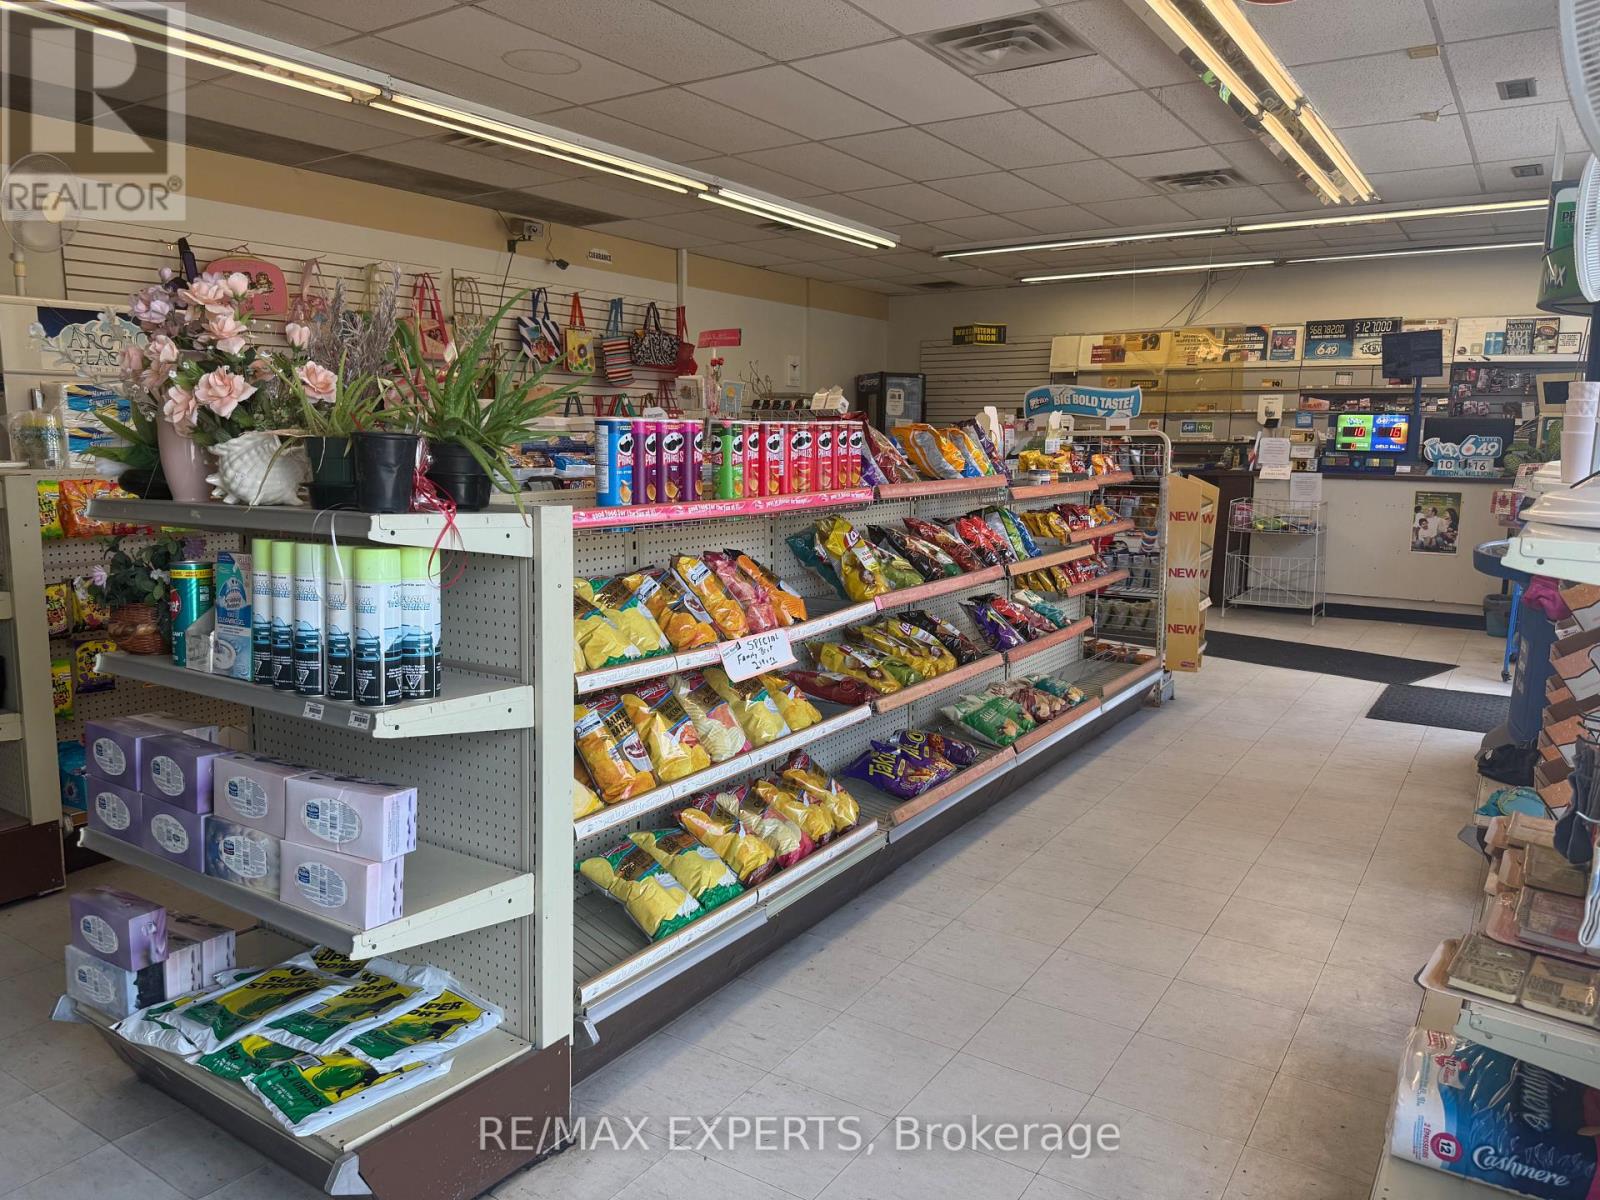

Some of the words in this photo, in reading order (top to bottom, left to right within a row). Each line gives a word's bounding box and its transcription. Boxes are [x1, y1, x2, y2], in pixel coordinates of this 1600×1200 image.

[67, 327, 152, 350] ARCTC
[1053, 394, 1071, 406] BIG
[1072, 394, 1099, 407] BOLD
[1099, 395, 1135, 410] TASTE!
[1460, 437, 1500, 456] 649
[1439, 460, 1453, 469] 10
[1169, 511, 1198, 522] NEW
[1168, 567, 1198, 578] NEW
[1167, 623, 1197, 634] NEW
[747, 633, 779, 651] SPECIAL
[246, 982, 320, 990] STRONG
[351, 981, 398, 993] UPER
[1439, 1140, 1452, 1154] 12
[1472, 1145, 1570, 1187] Cashmere
